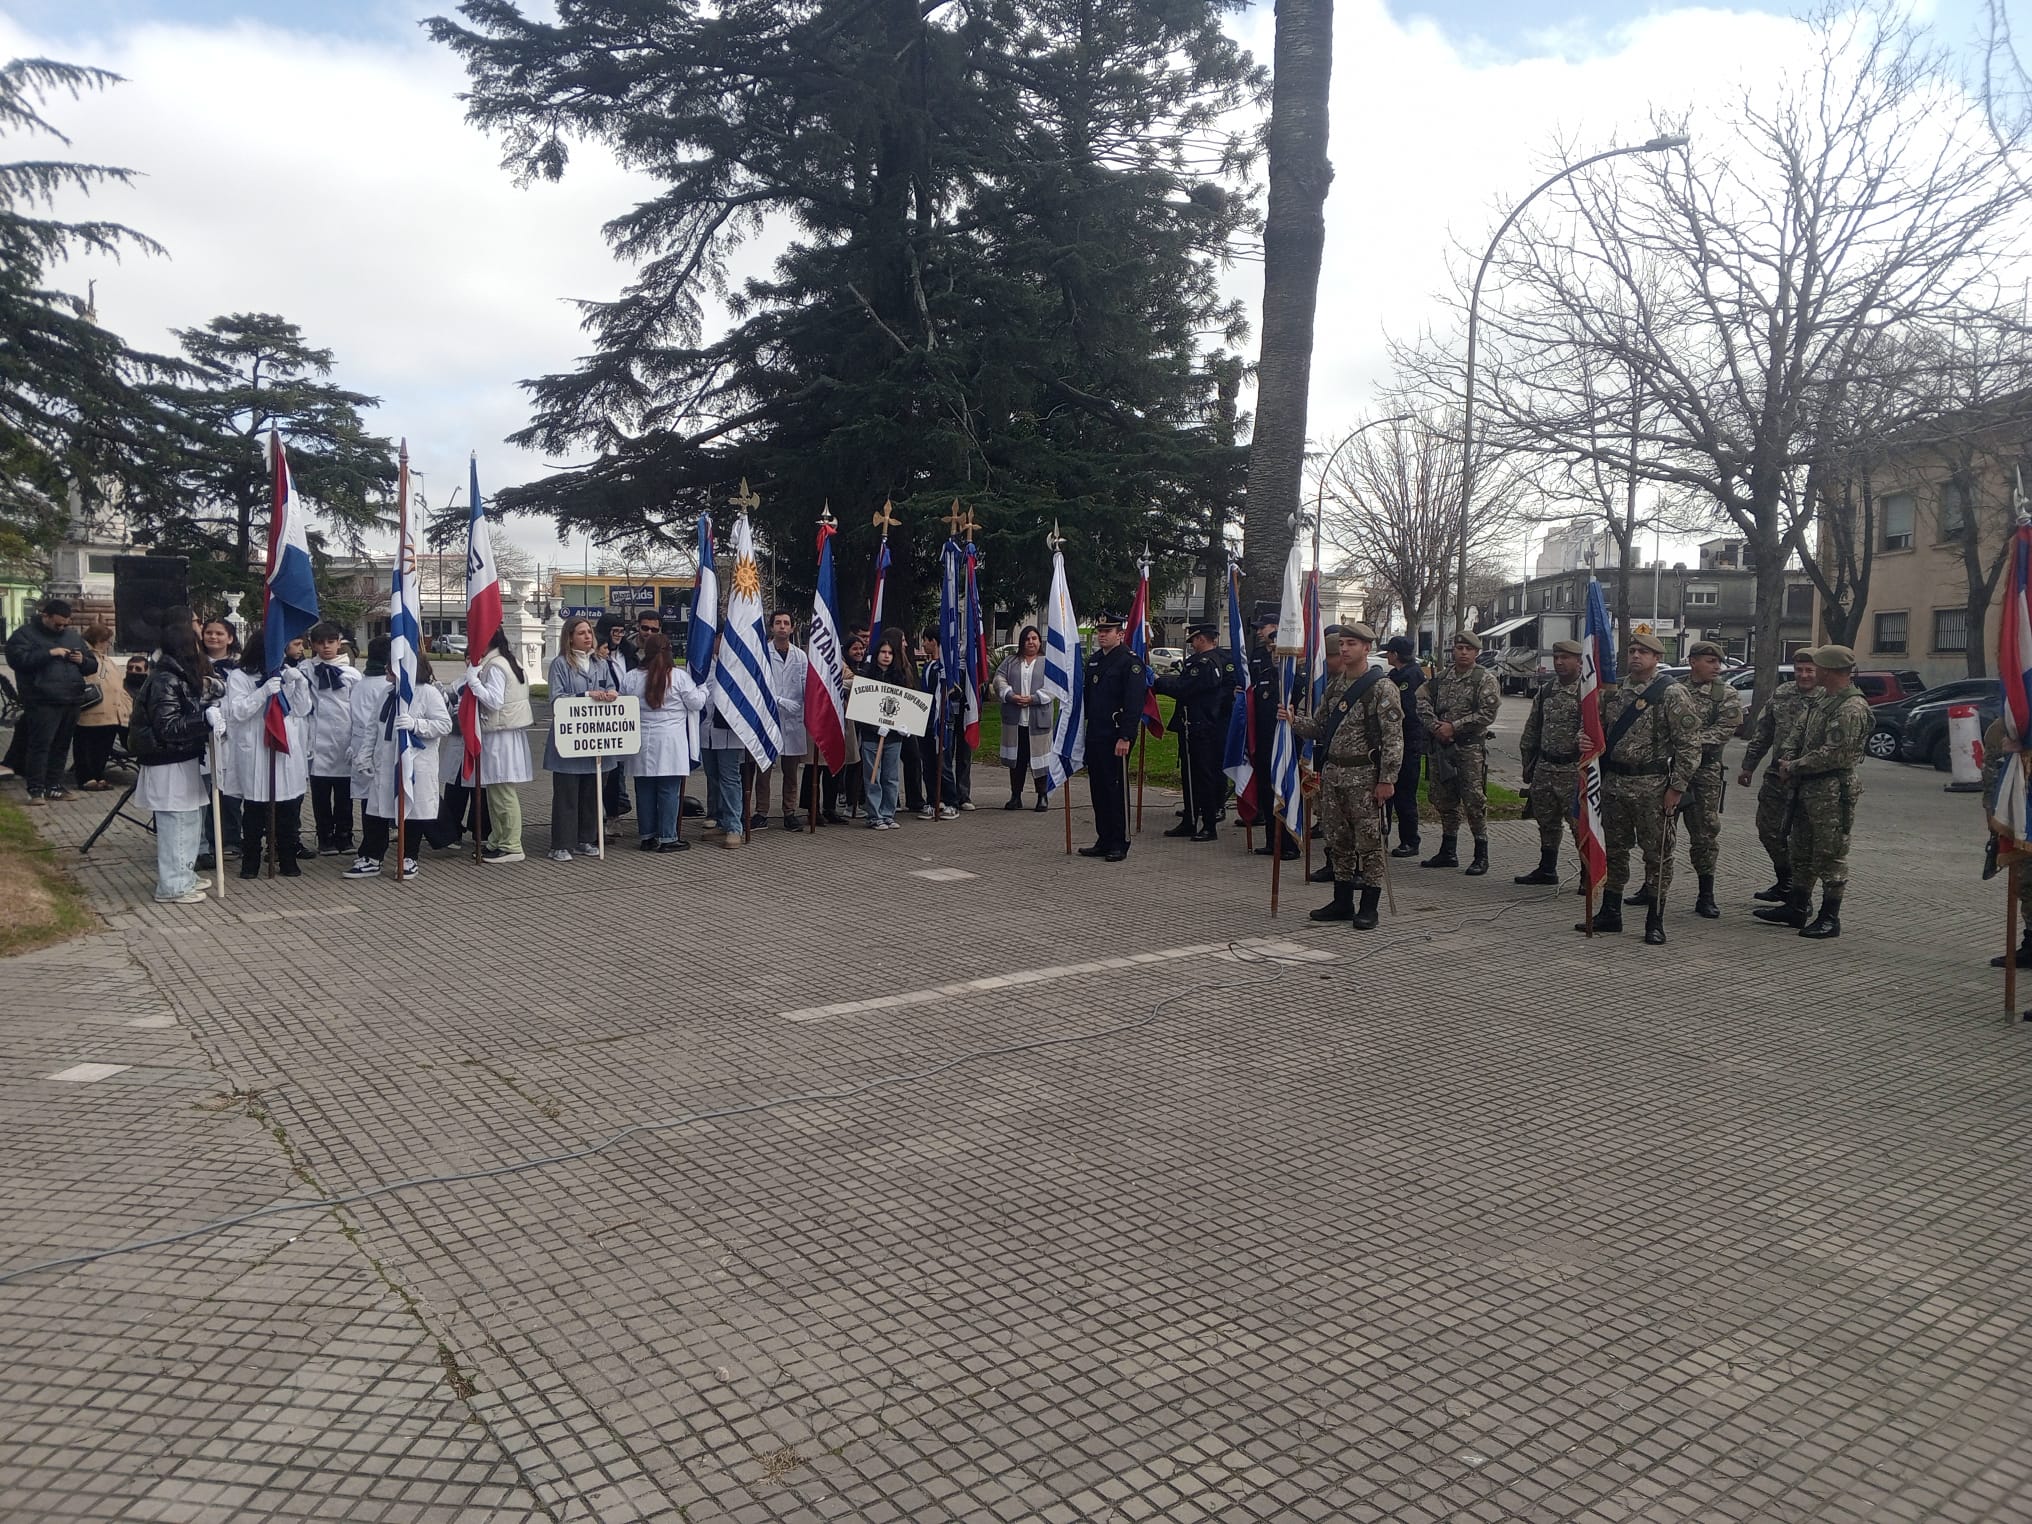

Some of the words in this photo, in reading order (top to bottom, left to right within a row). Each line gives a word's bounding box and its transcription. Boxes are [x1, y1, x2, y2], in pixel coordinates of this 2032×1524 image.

[575, 609, 602, 617] Abtab
[854, 684, 879, 695] ESCUELA
[903, 692, 929, 713] SUPERIOR
[569, 704, 625, 718] INSTITUTO
[559, 723, 573, 735] DE
[576, 718, 635, 734] FORMACIÓN
[574, 737, 624, 751] DOCENTE
